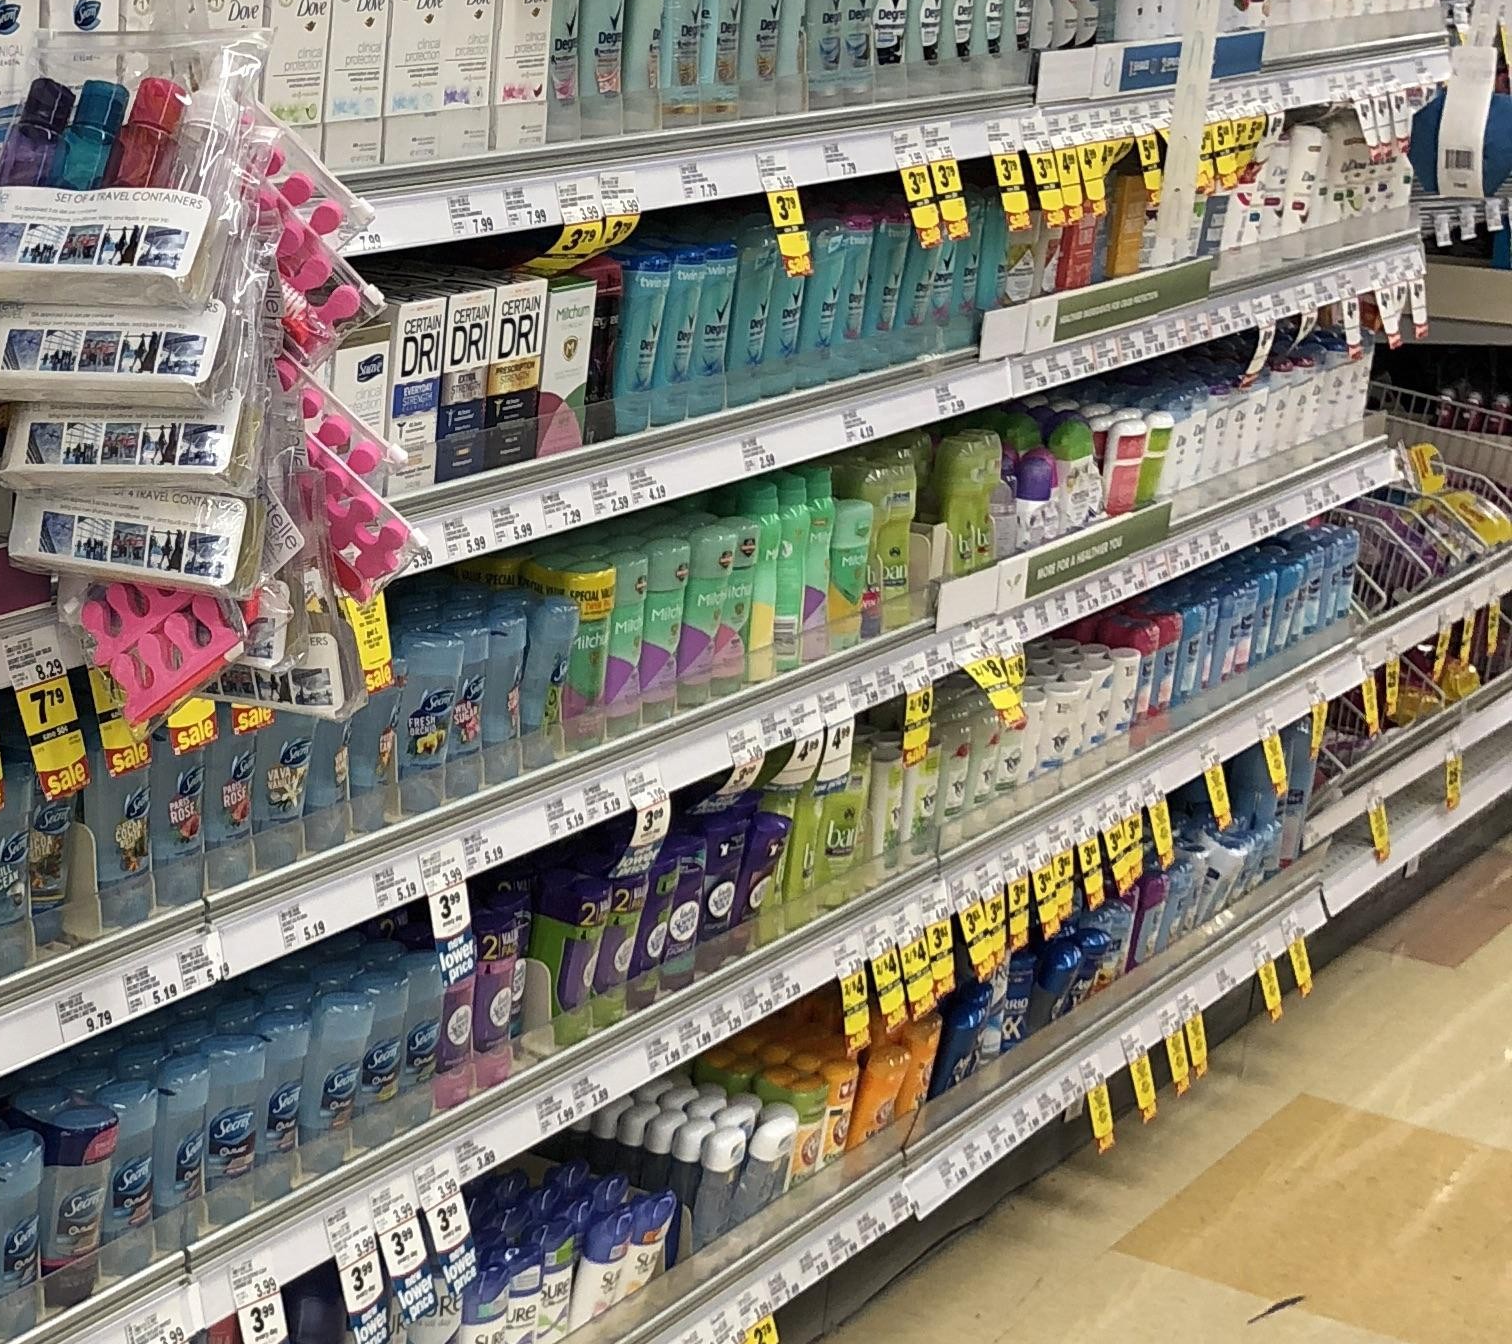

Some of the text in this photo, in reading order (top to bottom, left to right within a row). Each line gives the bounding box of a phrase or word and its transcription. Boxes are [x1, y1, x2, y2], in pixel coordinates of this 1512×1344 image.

[55, 192, 71, 202] SET
[73, 192, 88, 202] OF
[96, 191, 131, 202] TRAVEL
[133, 191, 204, 210] CONTAINERS
[472, 217, 494, 233] 7.99
[526, 209, 547, 224] 7.99
[453, 304, 490, 325] CERTAIN
[555, 304, 590, 322] Mitchum
[404, 314, 442, 335] CERTAIN
[450, 321, 489, 366] DRI
[401, 331, 442, 378] DRI
[358, 359, 383, 378] Suave
[403, 383, 434, 397] EVERYDAY
[562, 510, 582, 526] 7.29
[514, 523, 533, 540] 5.99
[466, 537, 486, 553] 5.99
[408, 715, 437, 730] FRESH
